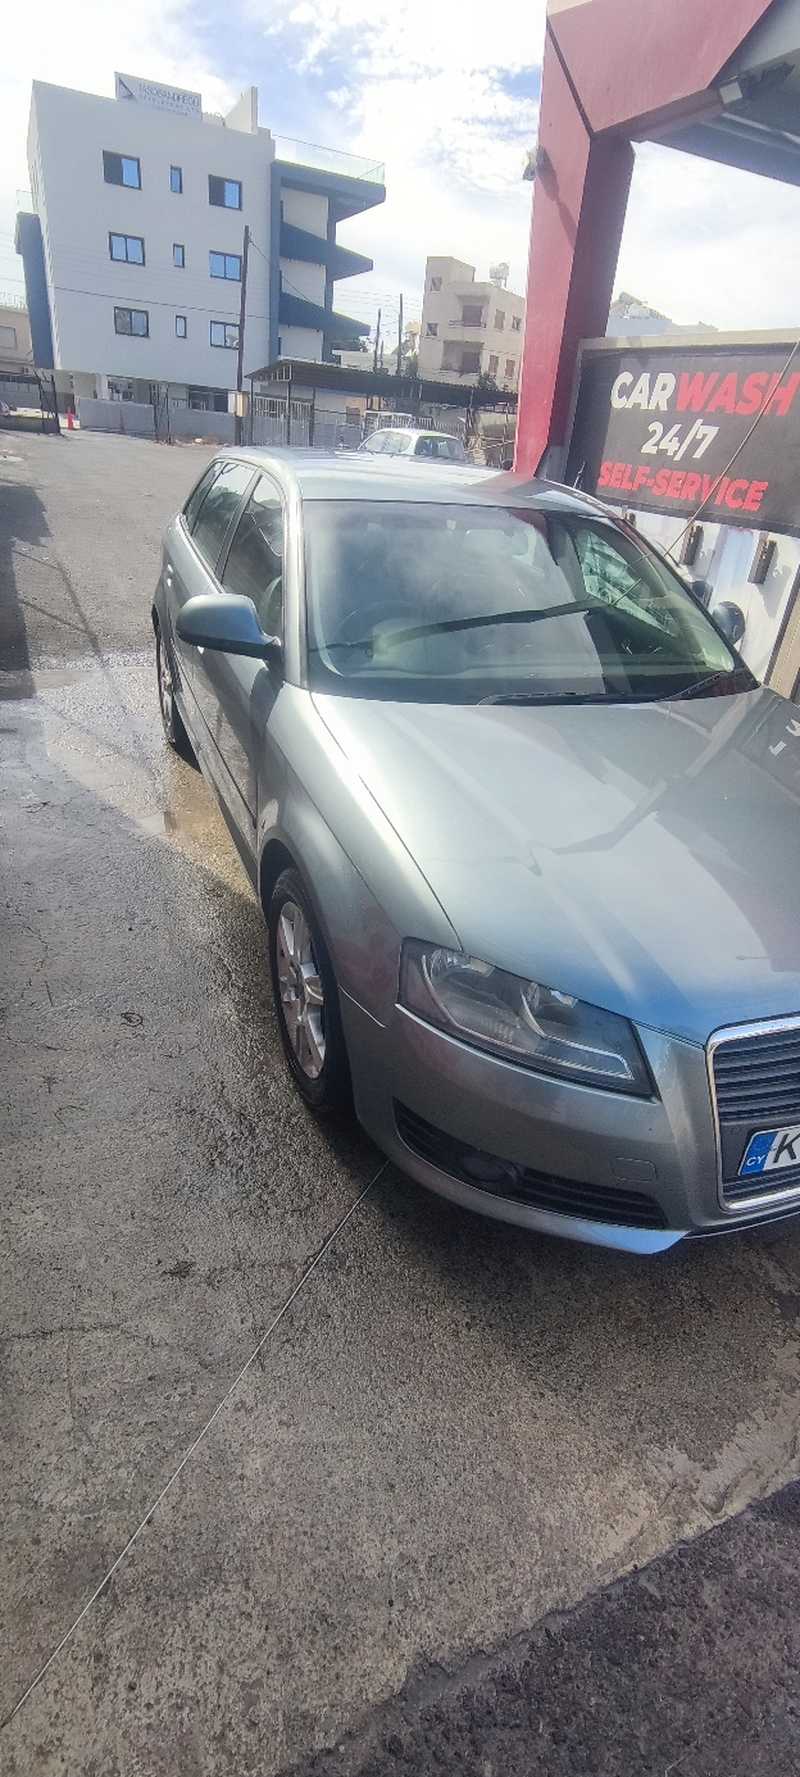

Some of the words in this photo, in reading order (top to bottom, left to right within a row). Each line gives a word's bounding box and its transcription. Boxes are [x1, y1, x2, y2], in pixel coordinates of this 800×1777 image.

[640, 418, 720, 461] 24/7
[597, 460, 769, 512] SELF-SERVICE
[746, 1155, 766, 1167] CY
